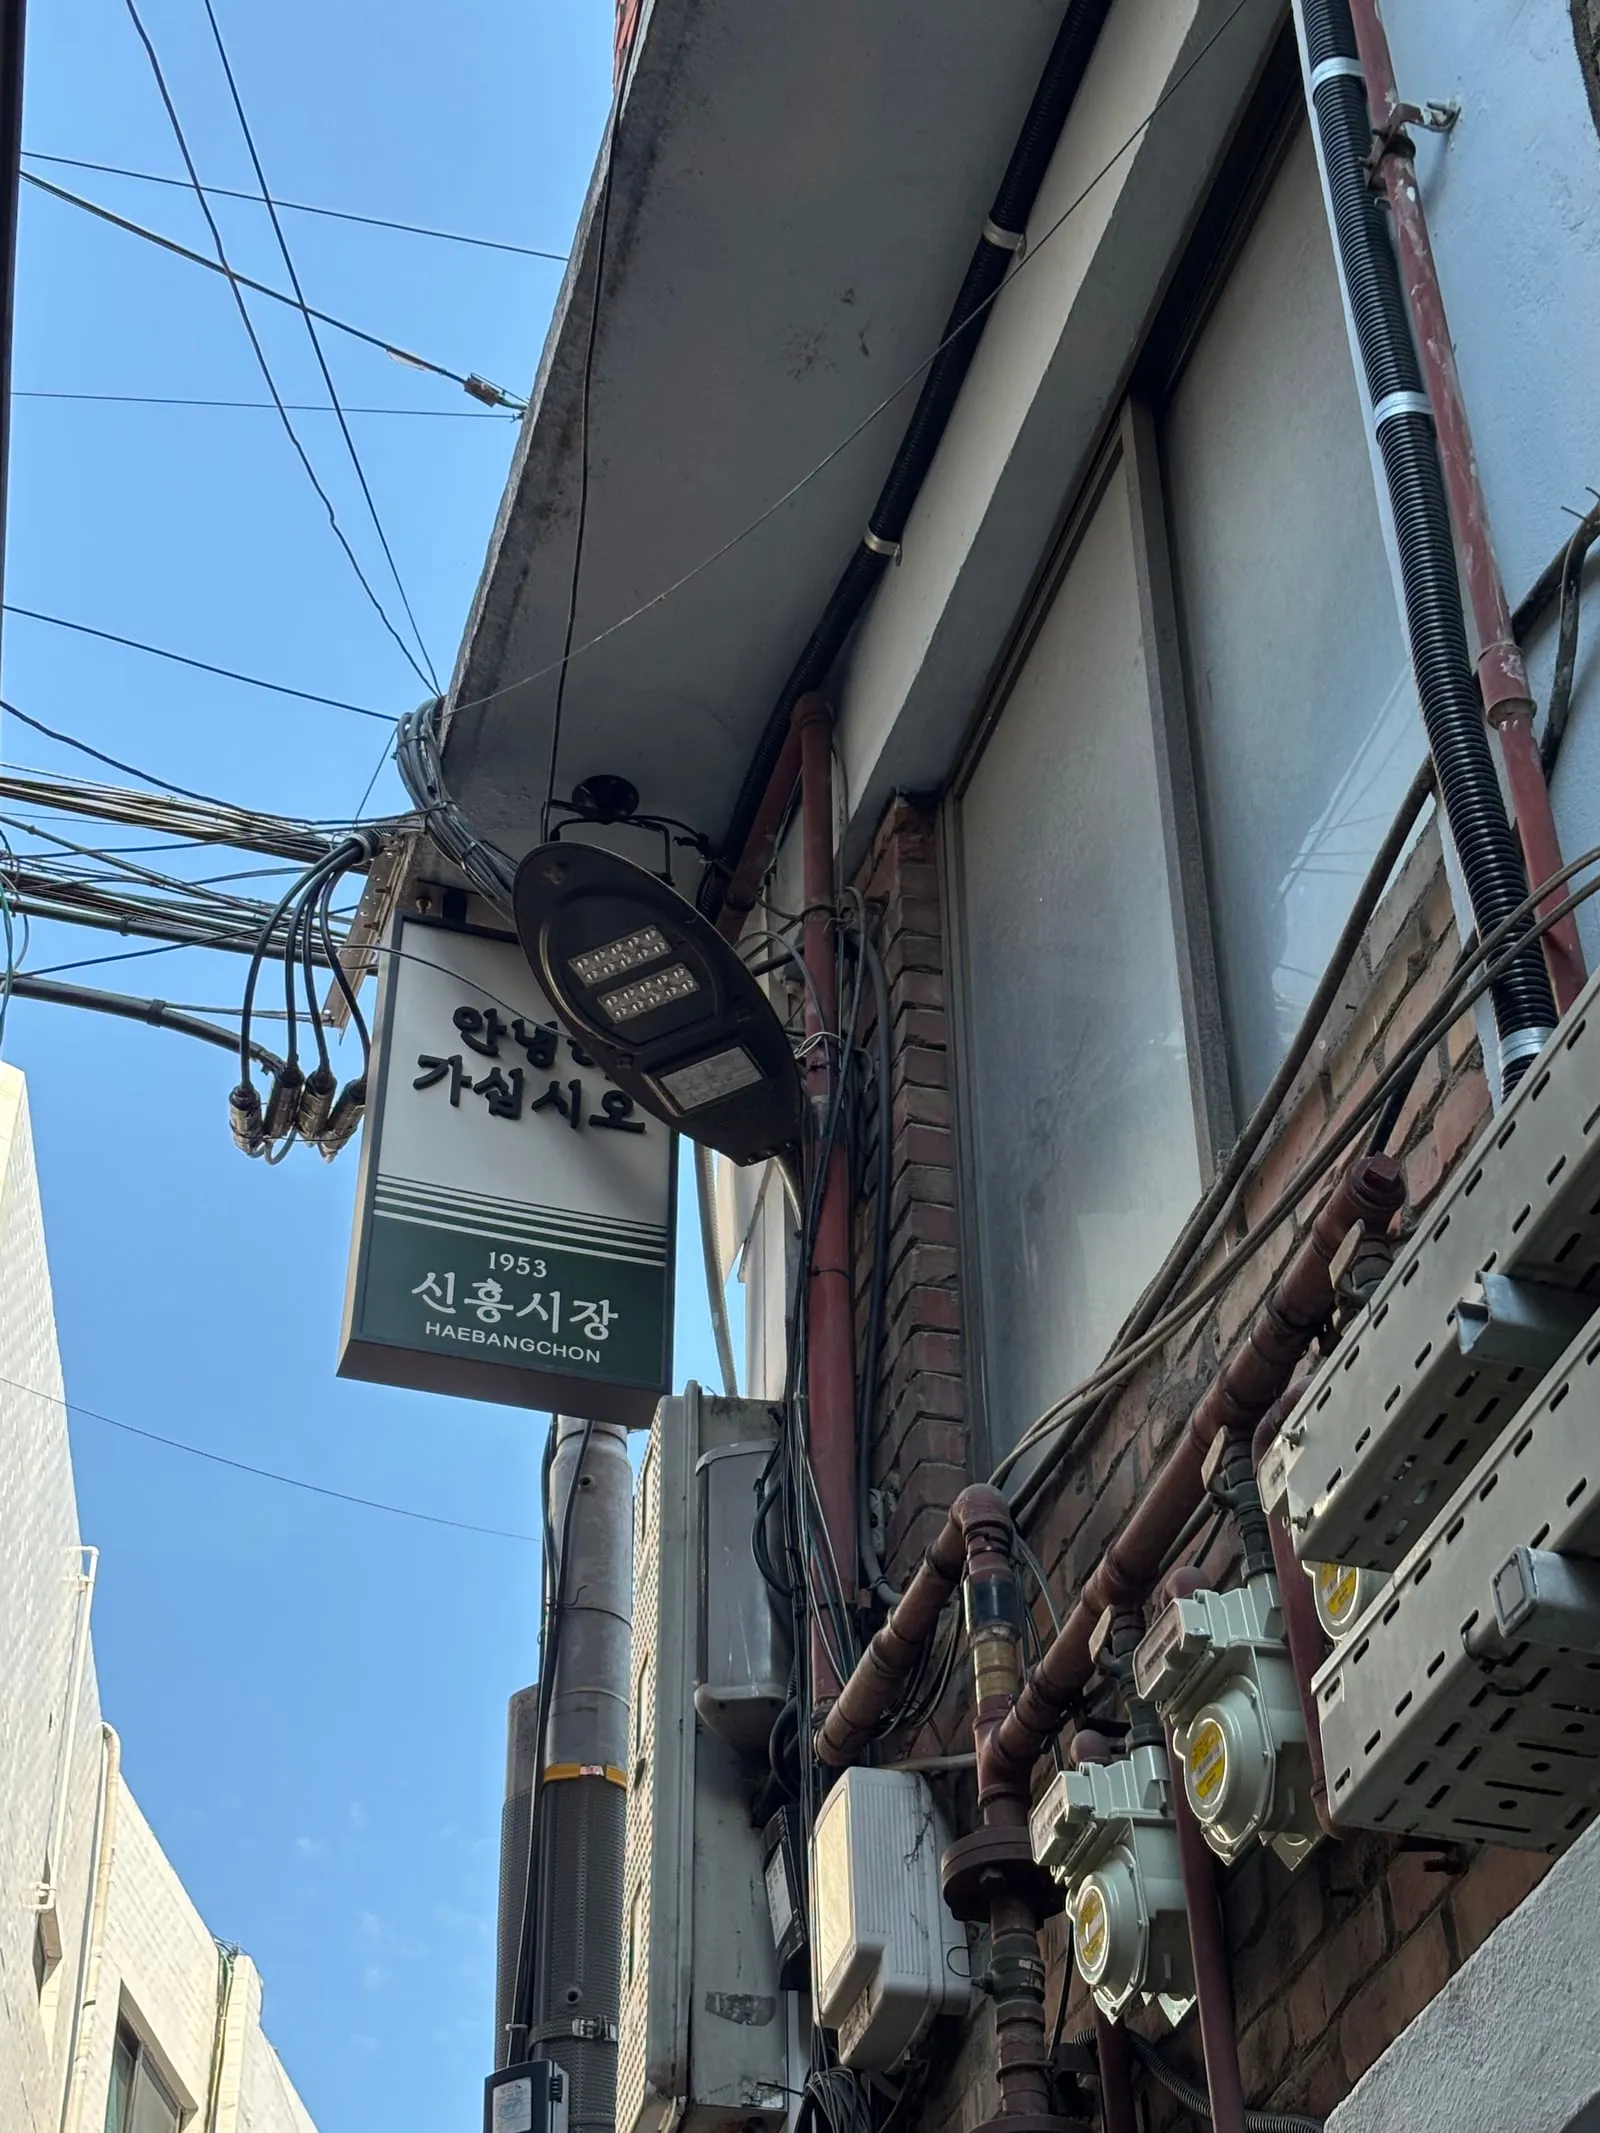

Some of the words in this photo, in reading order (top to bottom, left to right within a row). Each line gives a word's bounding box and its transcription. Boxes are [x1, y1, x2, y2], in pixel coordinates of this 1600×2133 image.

[413, 1054, 647, 1134] 가십시오
[488, 1251, 548, 1278] 1953
[411, 1271, 619, 1341] 신흥시장
[425, 1320, 601, 1364] HAEBANGCHON
